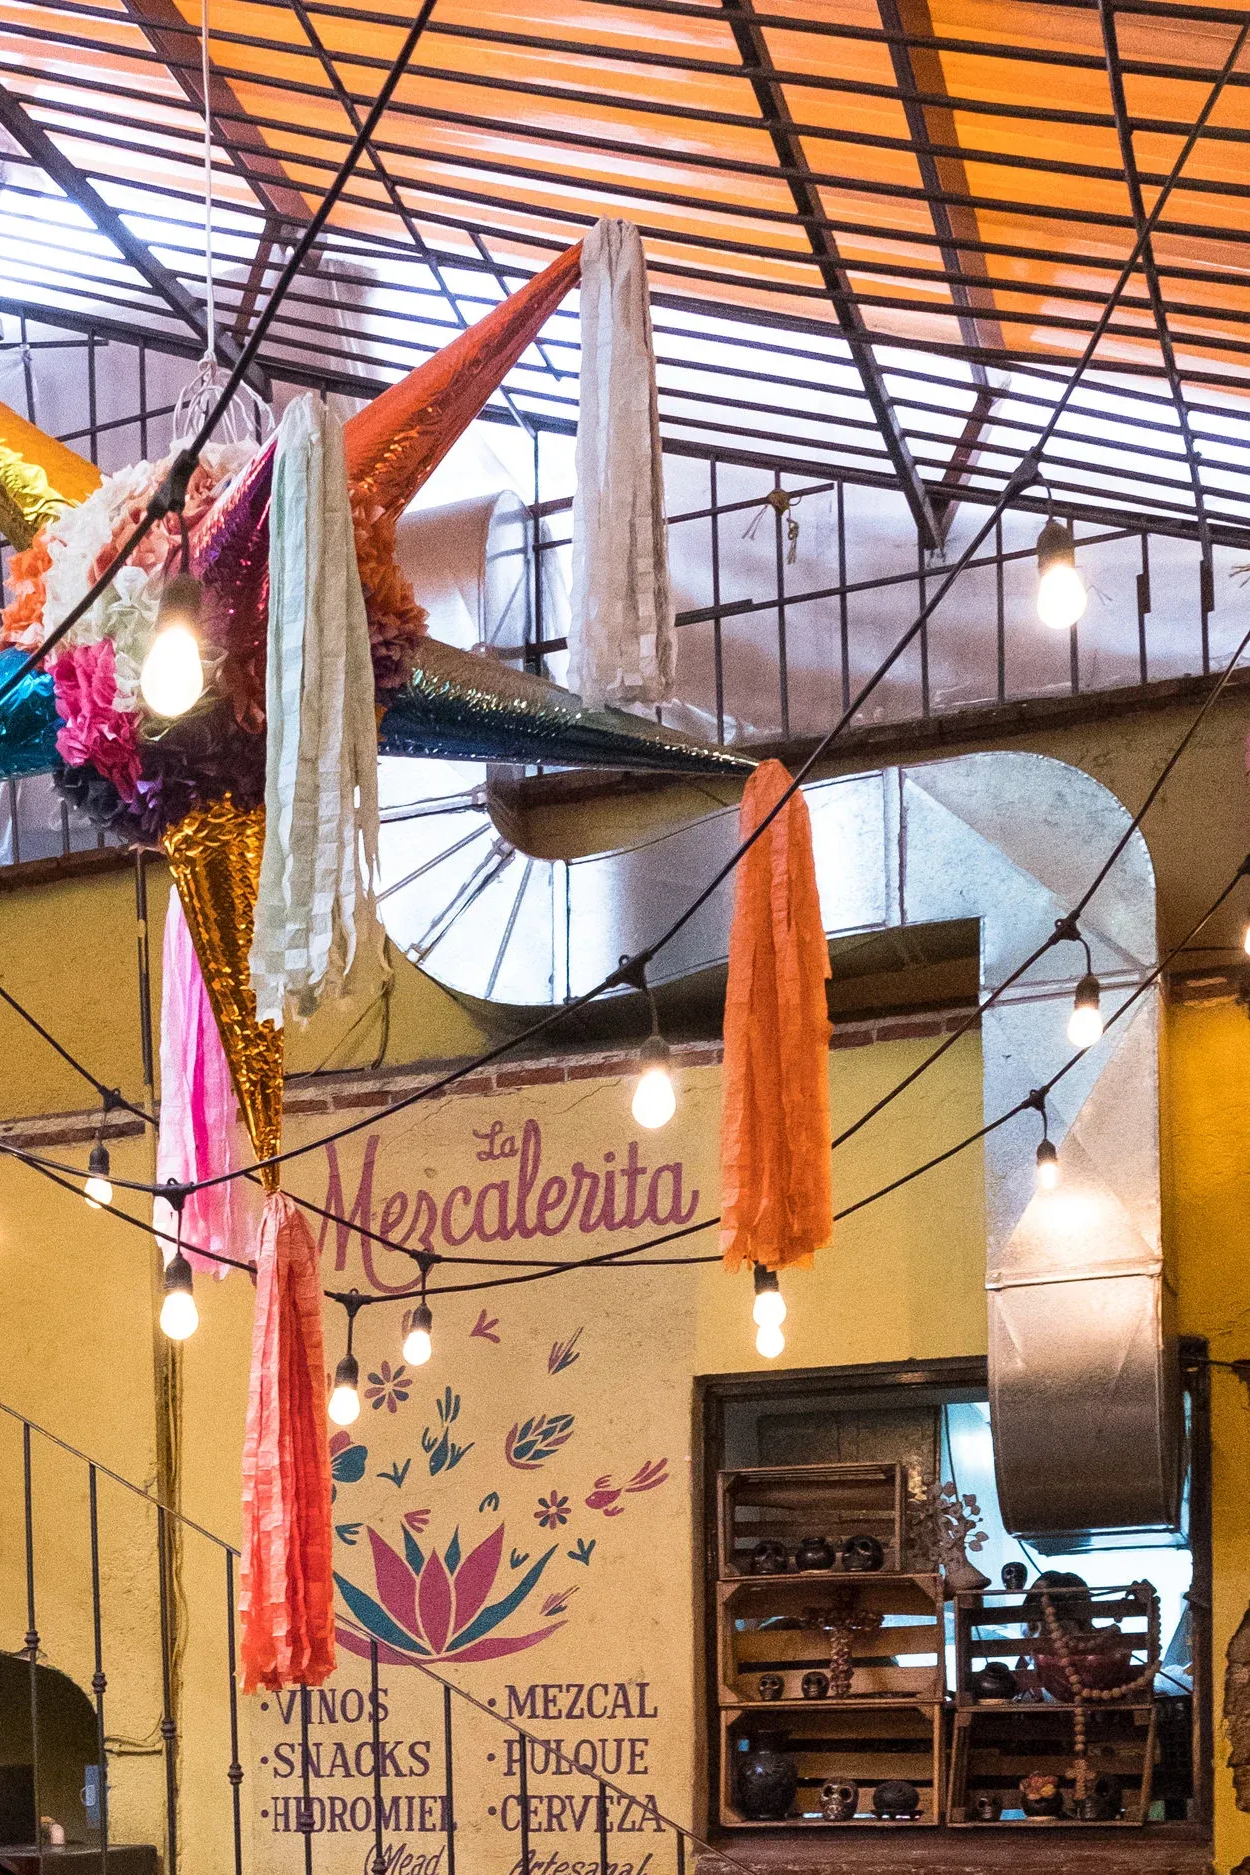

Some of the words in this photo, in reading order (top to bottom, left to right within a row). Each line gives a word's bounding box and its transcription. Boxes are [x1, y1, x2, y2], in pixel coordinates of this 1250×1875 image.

[472, 1119, 520, 1162] La
[318, 1118, 701, 1294] Mezcalerita
[271, 1687, 390, 1725] VINOS
[504, 1682, 659, 1720] MEZCAL
[273, 1740, 432, 1779] SNACKS
[503, 1738, 649, 1777] PULQUE
[271, 1795, 458, 1833] HIDROMIEL
[500, 1794, 667, 1833] CERVEZA
